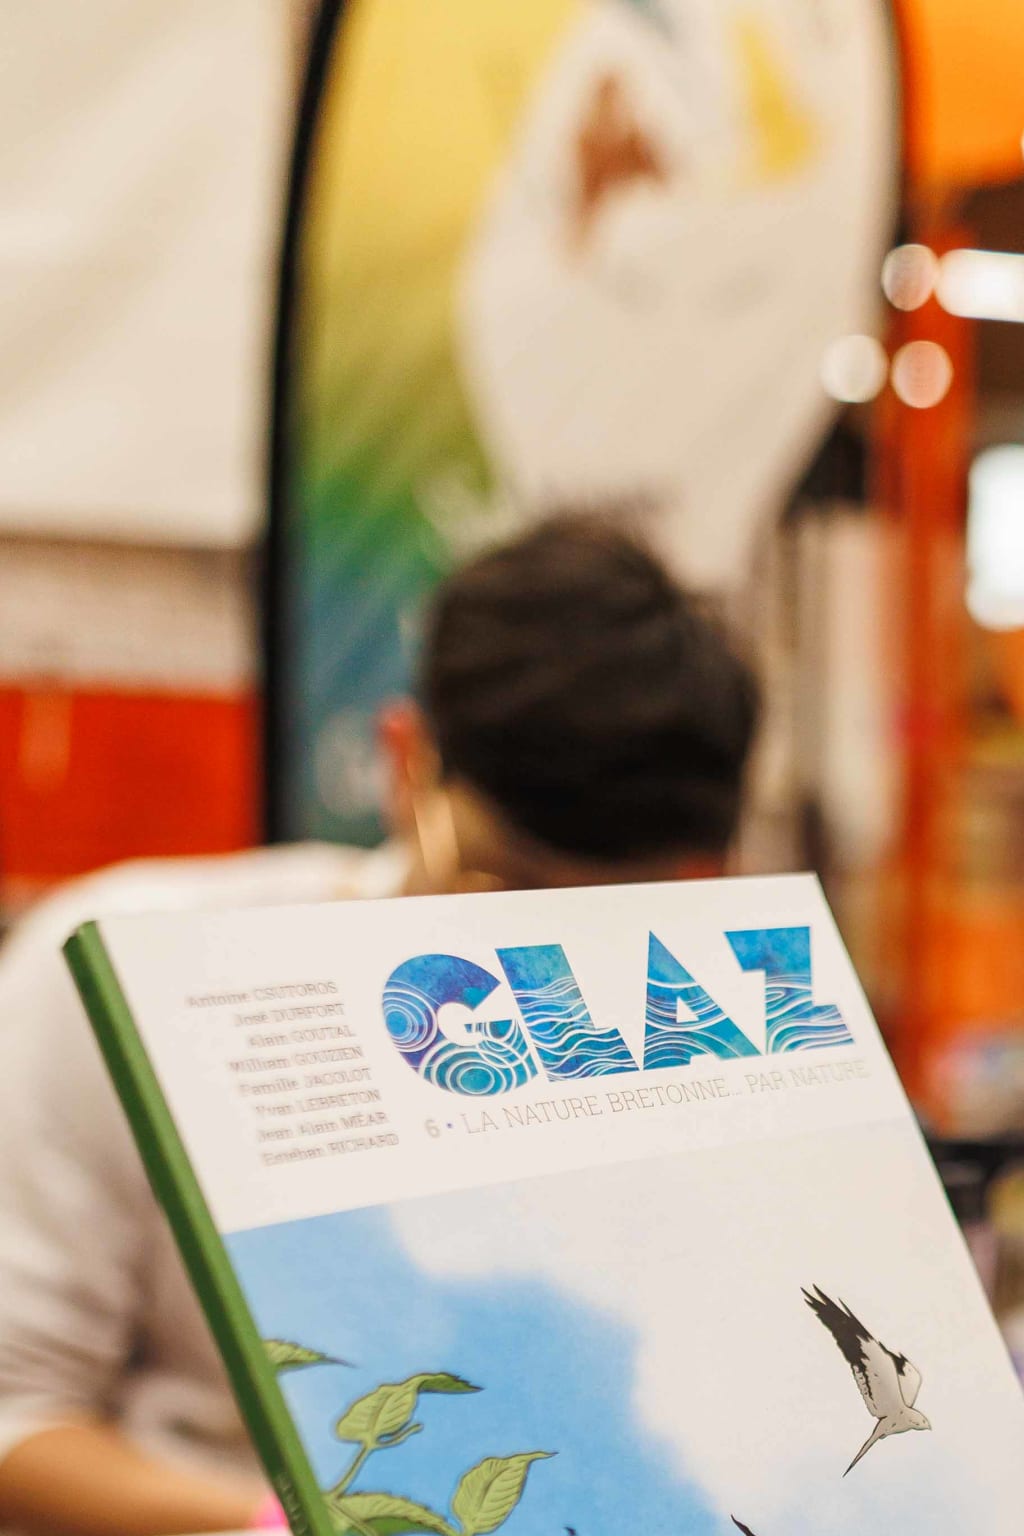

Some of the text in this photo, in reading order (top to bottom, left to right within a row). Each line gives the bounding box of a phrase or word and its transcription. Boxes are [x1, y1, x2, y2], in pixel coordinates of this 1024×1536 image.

[186, 990, 250, 1009] Antoine
[382, 925, 855, 1097] GLAZ
[228, 1055, 289, 1073] William
[239, 1077, 299, 1097] Famille
[424, 1118, 441, 1139] 6
[460, 1111, 500, 1134] LA
[502, 1095, 603, 1128] NATURE
[744, 1071, 786, 1094] PAR
[789, 1058, 872, 1087] NATURE
